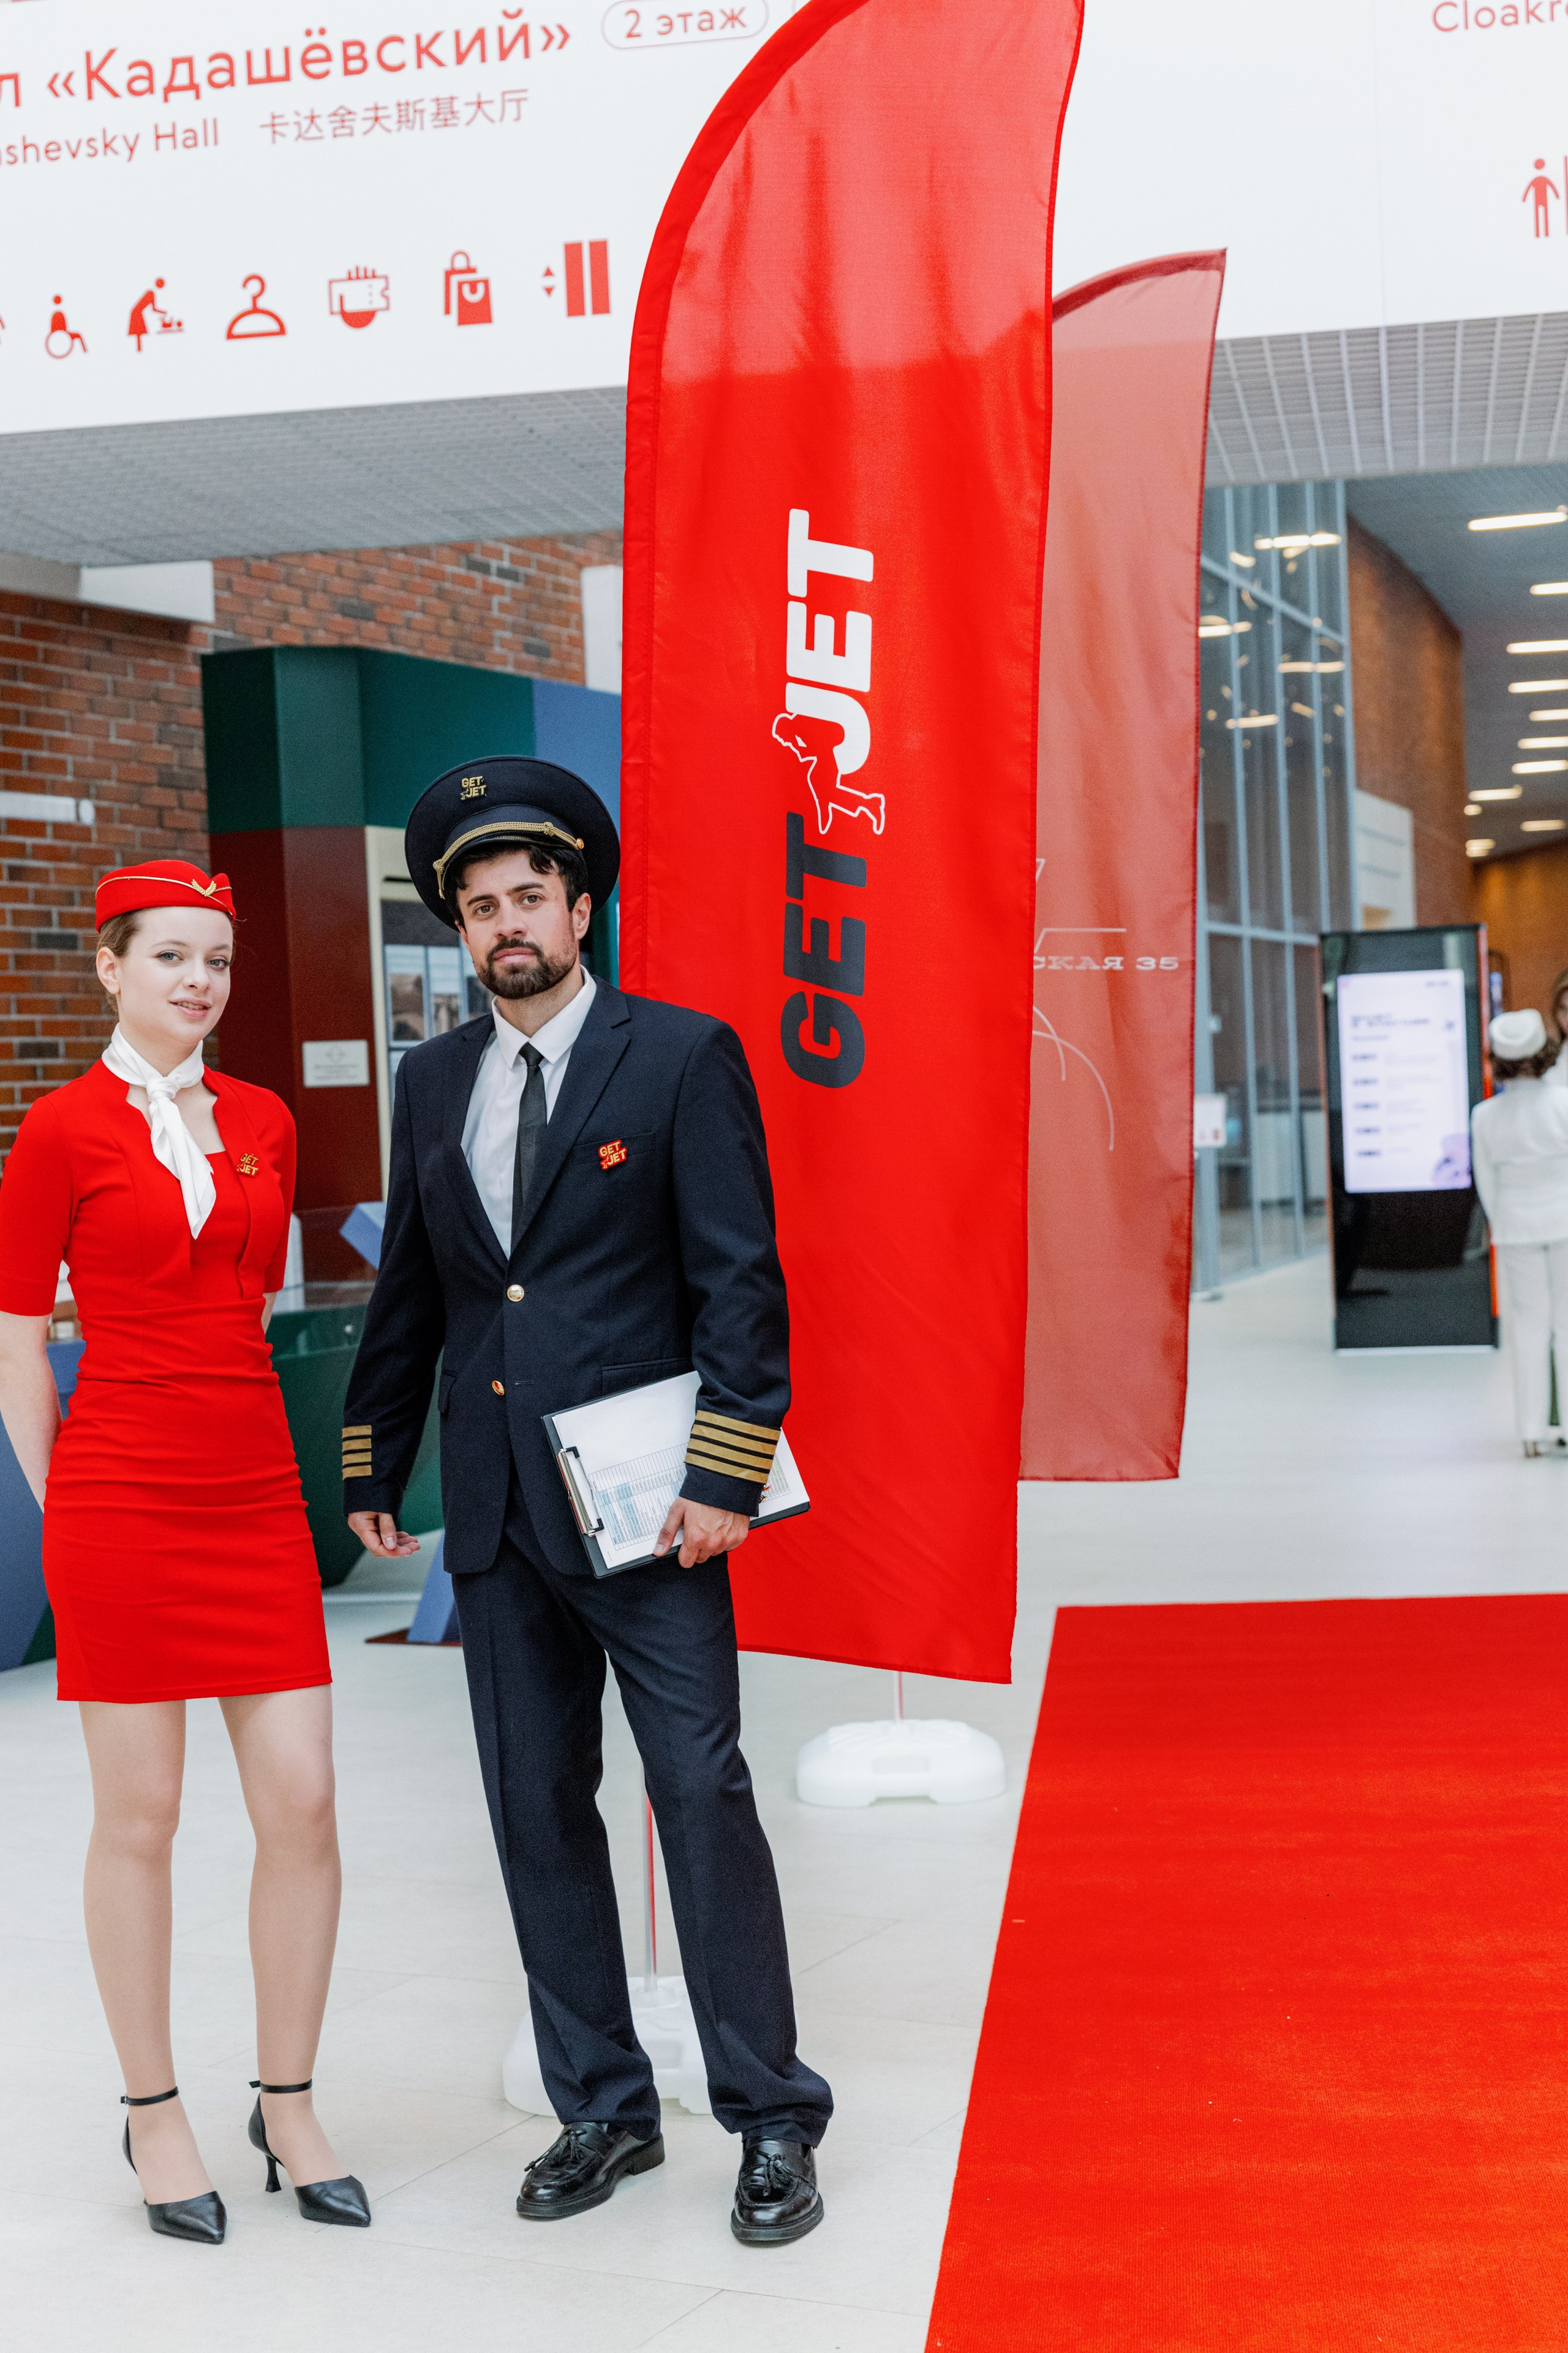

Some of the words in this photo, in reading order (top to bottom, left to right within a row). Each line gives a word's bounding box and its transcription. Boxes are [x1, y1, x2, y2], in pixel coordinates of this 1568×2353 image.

[625, 9, 642, 39] 2
[657, 6, 747, 36] этаж
[1432, 0, 1568, 32] Cloakr
[47, 8, 570, 103] «Кадашёвский»
[260, 88, 529, 145] 卡达舍夫斯基大厅
[0, 127, 141, 165] shevsky
[154, 118, 219, 151] Hall
[785, 508, 874, 776] JET
[462, 776, 483, 787] GET
[466, 785, 486, 797] JET
[780, 812, 867, 1089] GET
[1135, 956, 1179, 970] 35
[240, 1153, 259, 1166] GET
[600, 1141, 620, 1157] GET
[607, 1149, 626, 1165] JET
[239, 1164, 258, 1175] JET
